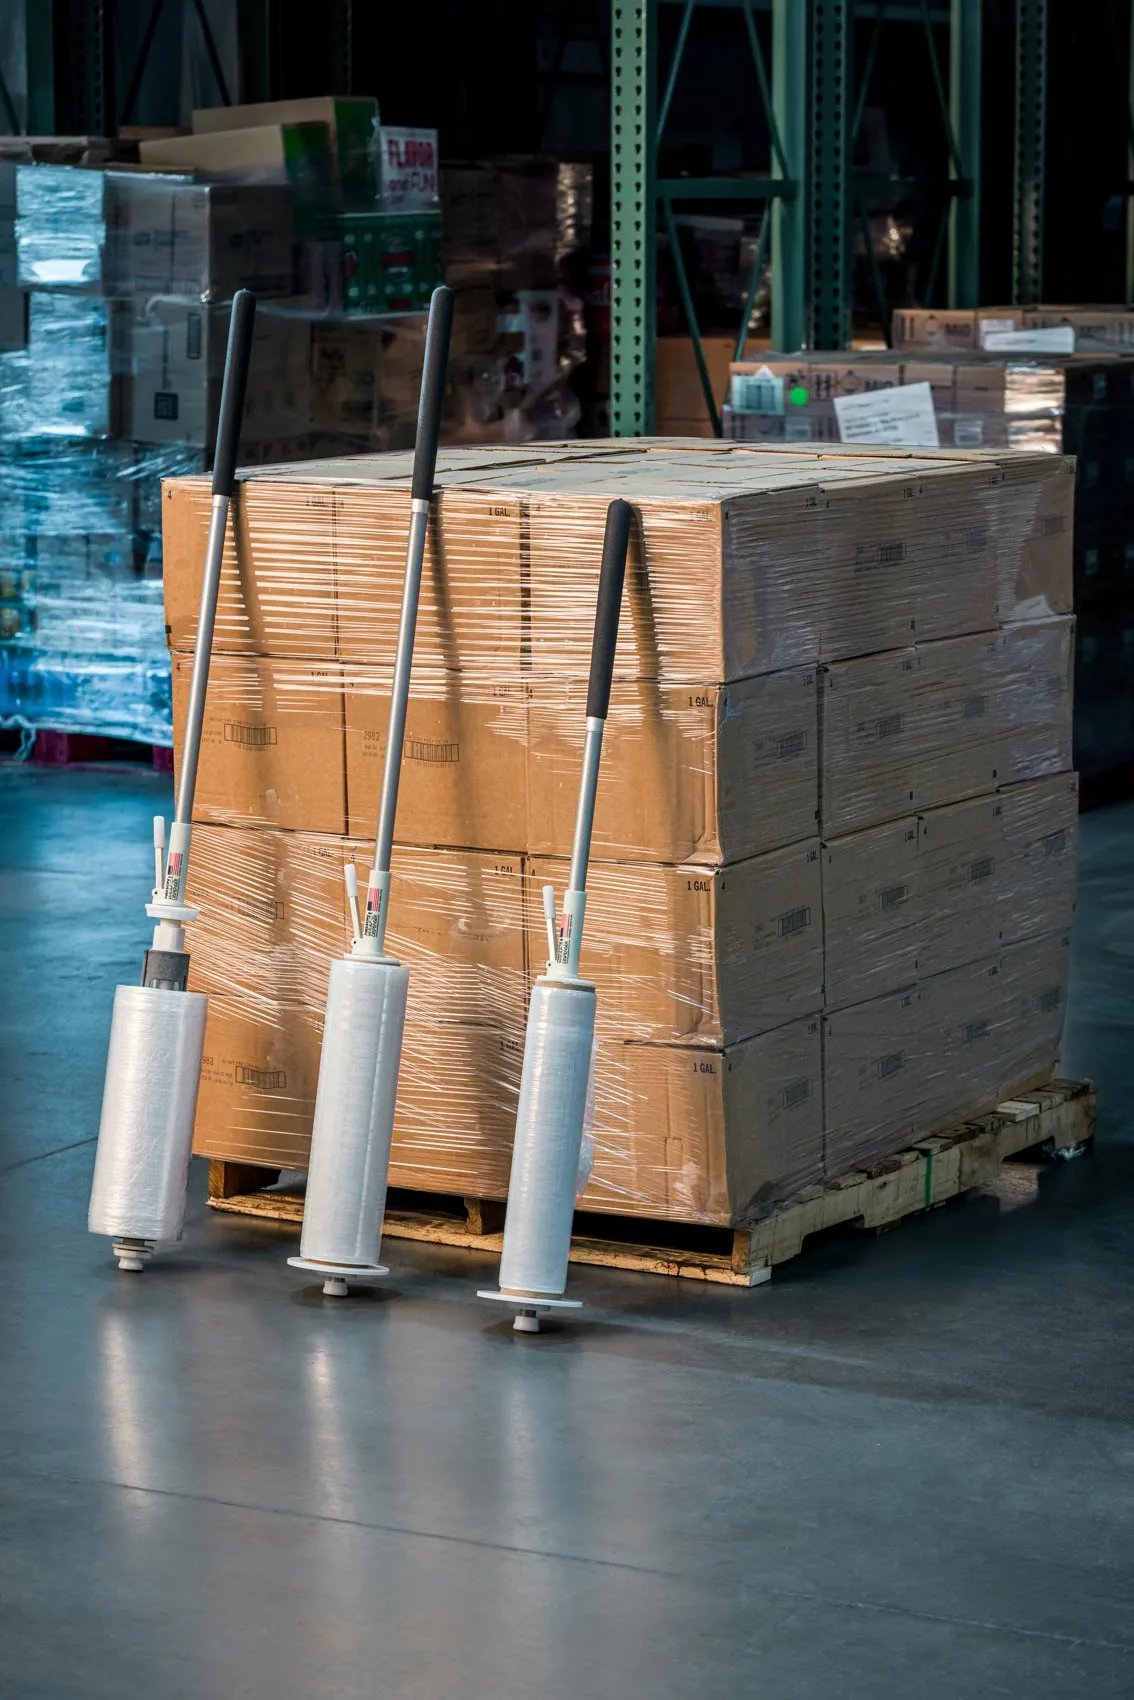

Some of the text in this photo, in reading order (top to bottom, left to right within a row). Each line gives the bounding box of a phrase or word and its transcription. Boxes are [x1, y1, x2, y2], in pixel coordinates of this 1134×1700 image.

[495, 507, 511, 517] GAL.
[689, 697, 714, 707] 1 GAL.
[687, 881, 711, 892] 1 GAL.
[693, 1062, 717, 1074] 1 GAL.
